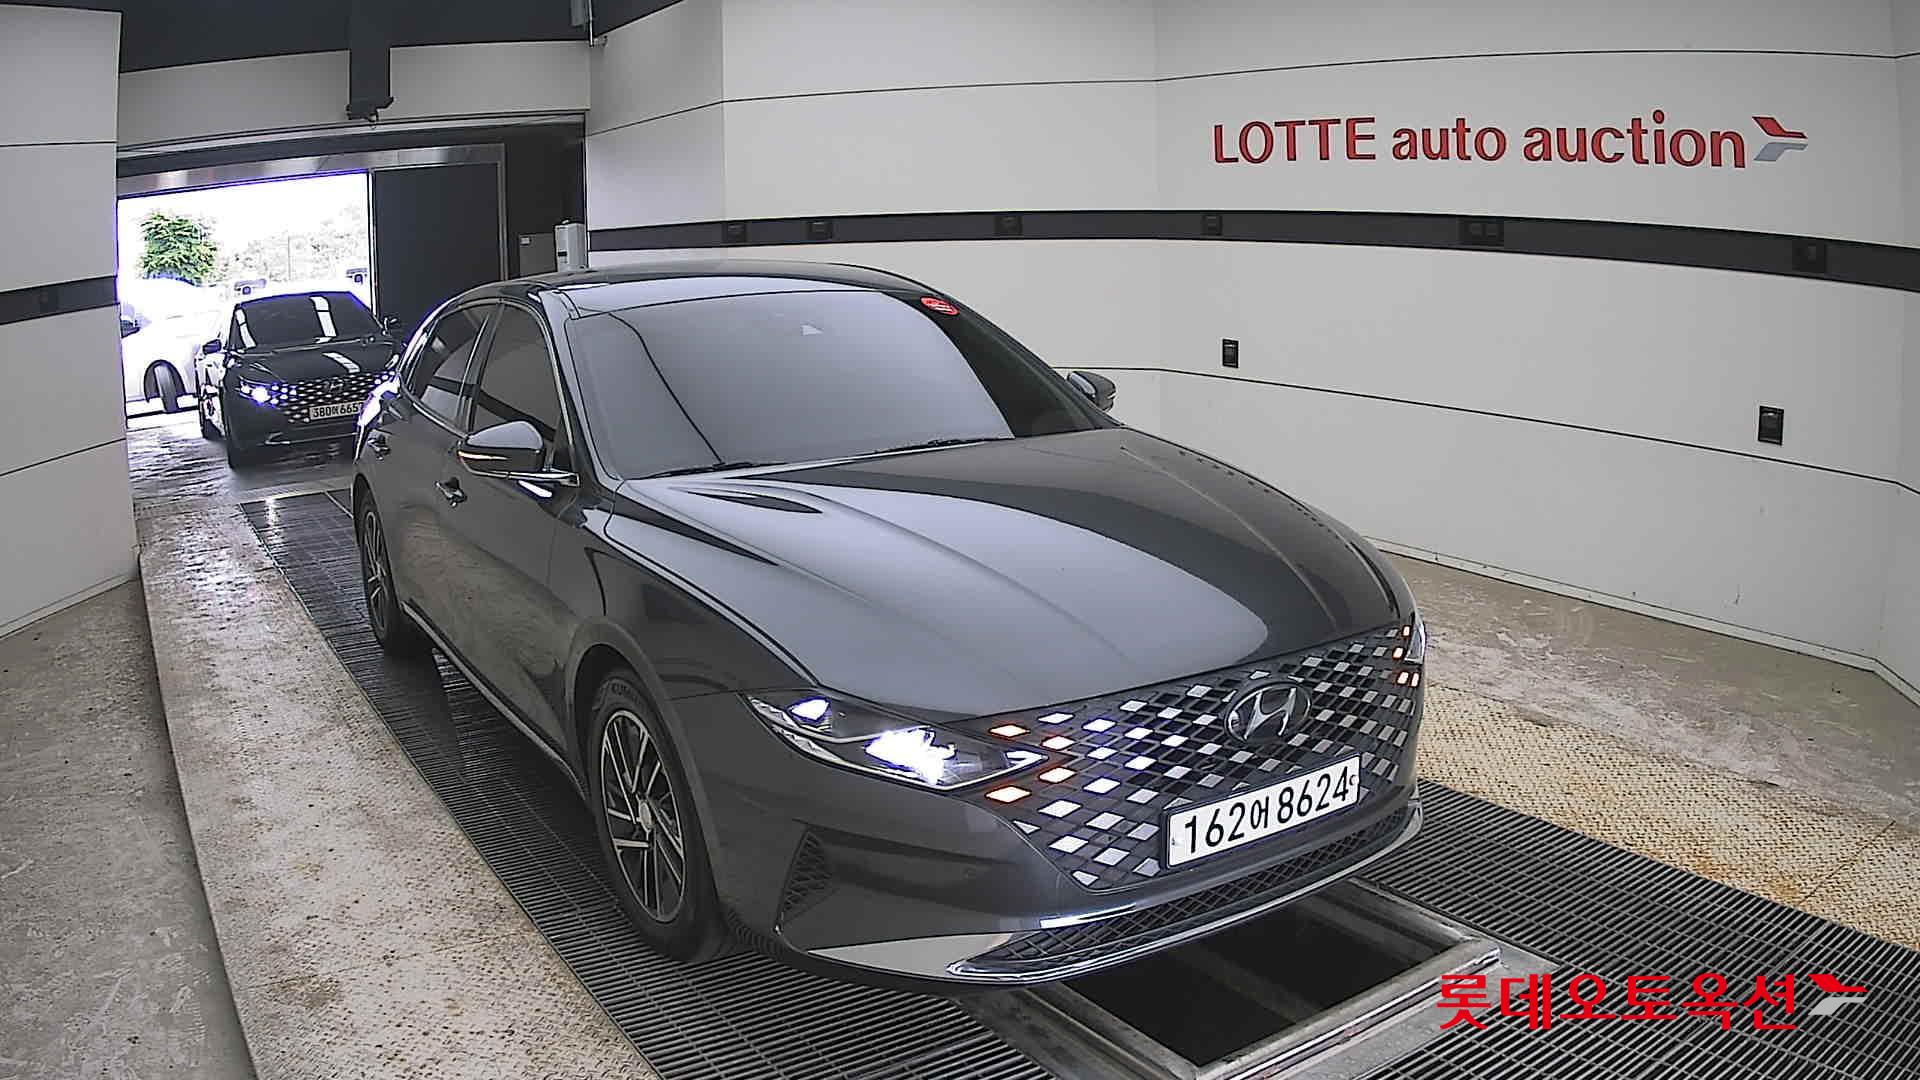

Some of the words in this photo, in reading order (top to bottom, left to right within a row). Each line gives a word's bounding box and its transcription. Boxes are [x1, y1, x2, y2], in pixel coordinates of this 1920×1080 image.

[1213, 116, 1377, 164] LOTTE
[1391, 117, 1507, 161] auto
[1522, 109, 1746, 169] auction
[1184, 795, 1270, 854] 162어
[1277, 766, 1349, 825] 8624
